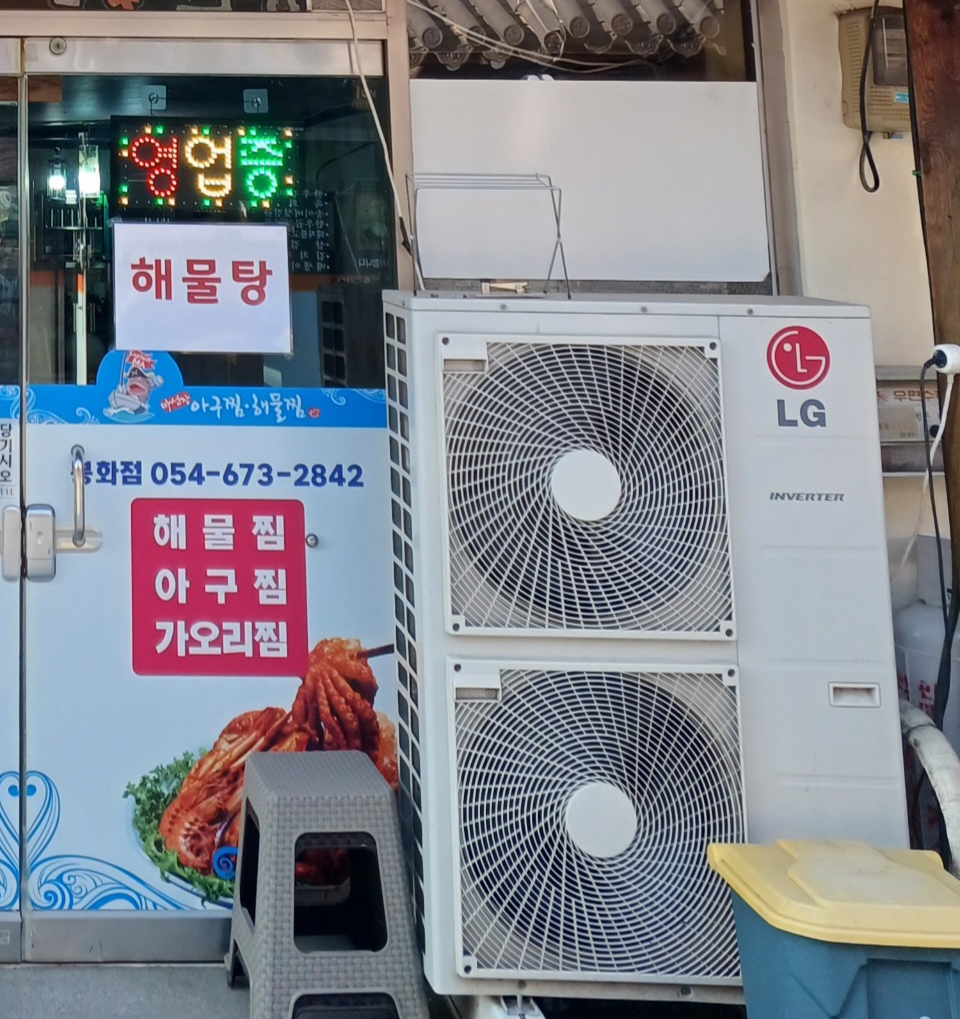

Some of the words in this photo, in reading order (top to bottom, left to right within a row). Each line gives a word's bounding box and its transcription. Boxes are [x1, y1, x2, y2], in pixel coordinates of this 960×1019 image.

[131, 136, 283, 198] 영업중
[131, 257, 273, 306] 해물탕
[776, 399, 827, 427] LG
[0, 423, 13, 483] 당기시오
[150, 462, 364, 487] 054-673-2842
[769, 492, 844, 502] INVERTER
[153, 514, 285, 550] 해물찜
[154, 568, 287, 605] 아구찜
[155, 621, 288, 657] 가오리찜
